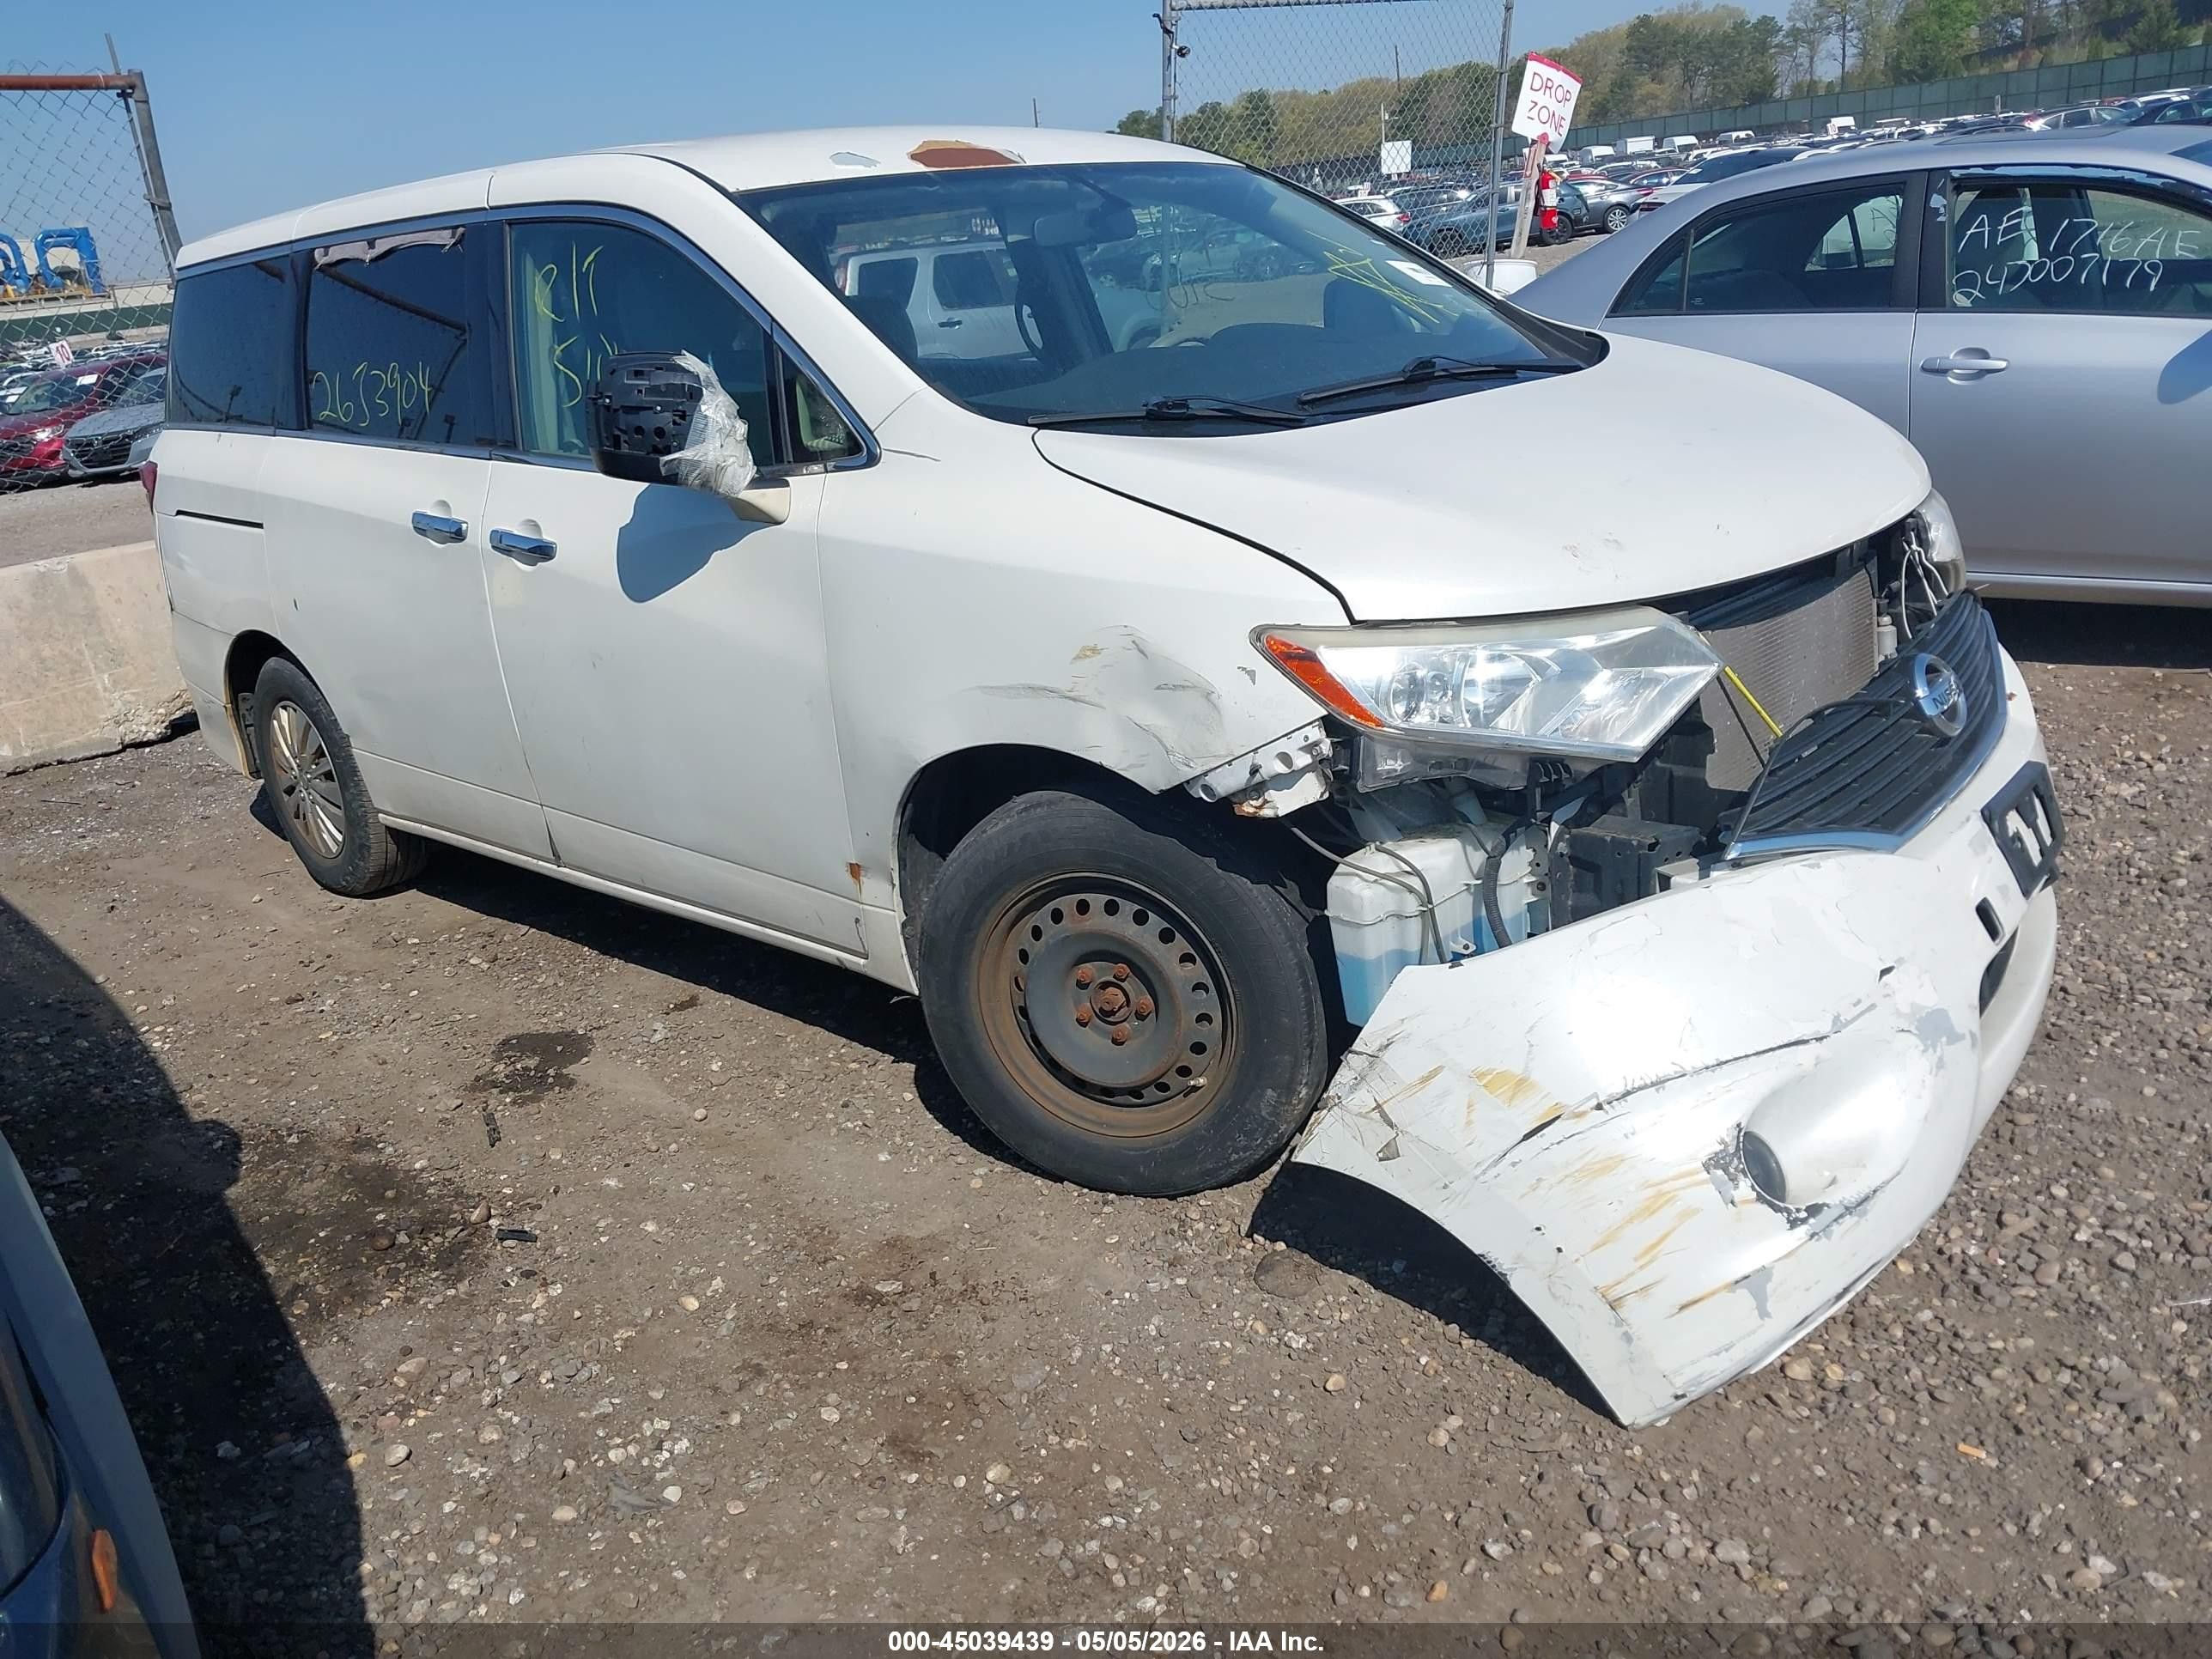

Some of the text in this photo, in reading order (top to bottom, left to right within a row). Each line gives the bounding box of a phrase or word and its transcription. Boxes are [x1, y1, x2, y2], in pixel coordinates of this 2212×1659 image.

[1529, 71, 1572, 108] DROP
[1527, 100, 1566, 137] ZONE
[1958, 205, 2033, 253] AE
